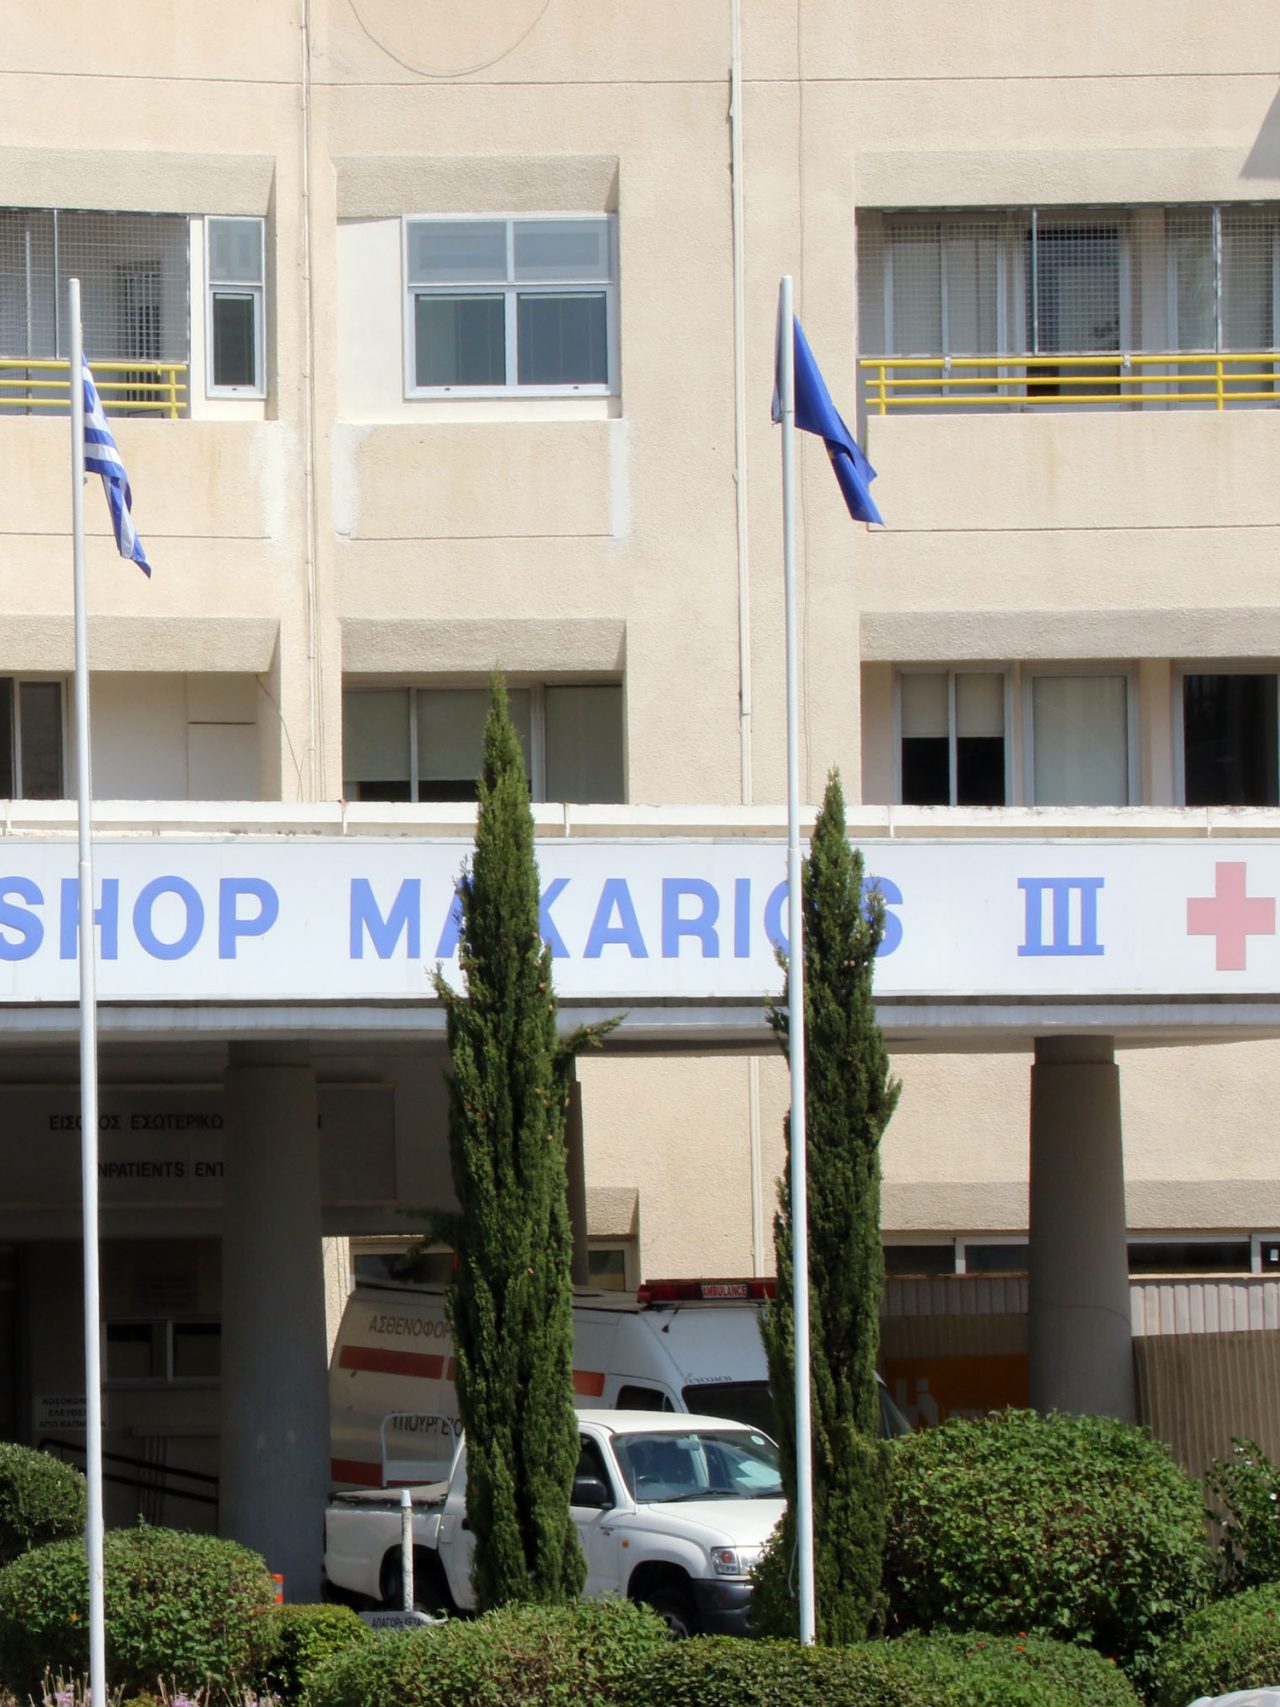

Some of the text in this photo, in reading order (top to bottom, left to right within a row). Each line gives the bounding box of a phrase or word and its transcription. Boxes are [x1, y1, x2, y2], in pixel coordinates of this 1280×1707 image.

[1017, 876, 1105, 957] III
[49, 1114, 223, 1130] ΕΙΣΟΣ ΕΣΩΤΕΡΙΚΩ
[98, 1162, 224, 1178] NPATIENTS ENT
[704, 1286, 747, 1297] AMBULANCE
[369, 1316, 452, 1338] ΑΣΘΕΝΟΦΟΡ
